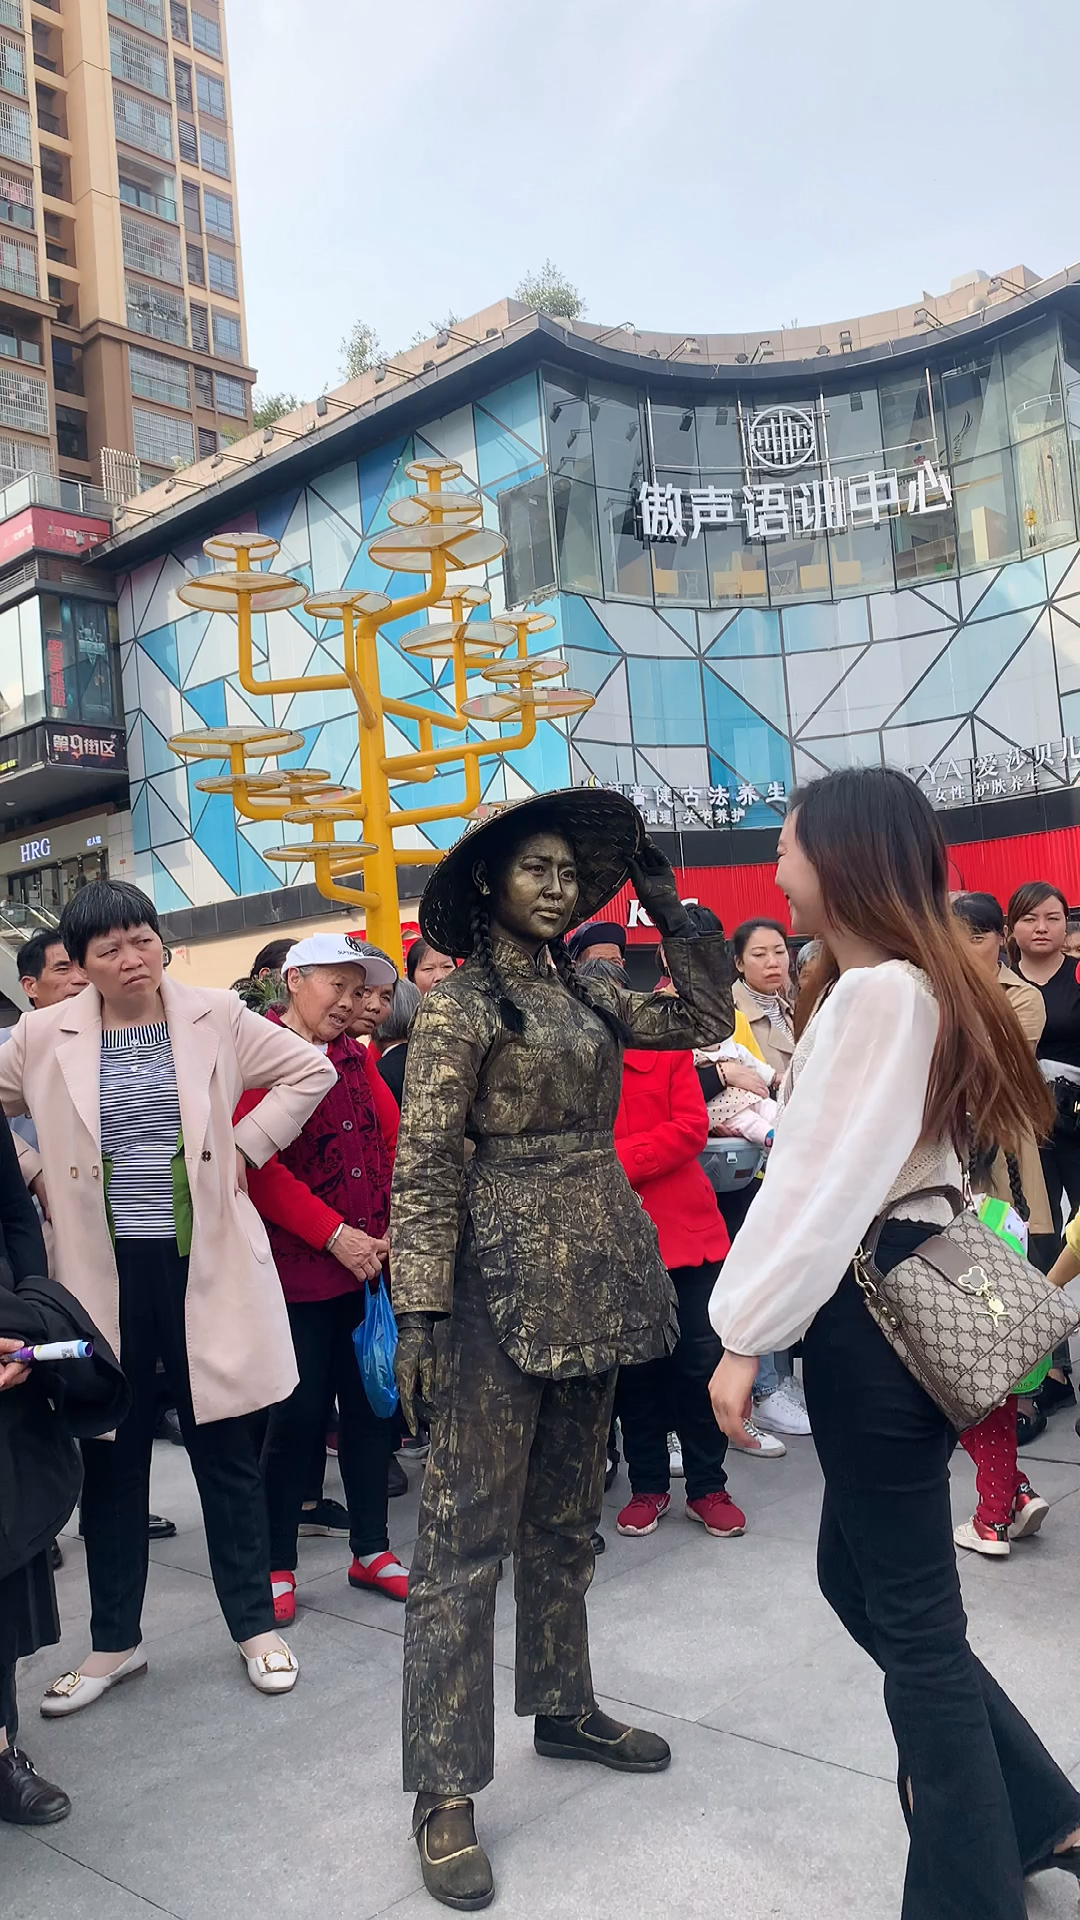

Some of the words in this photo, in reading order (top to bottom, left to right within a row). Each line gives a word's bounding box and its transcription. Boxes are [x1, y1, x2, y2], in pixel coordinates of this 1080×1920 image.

[639, 461, 952, 539] 傲声语训中心
[53, 734, 116, 759] 第9街区
[976, 771, 1040, 797] 护肤养生
[641, 808, 673, 825] 调理
[683, 807, 745, 825] 关节养护
[20, 838, 51, 862] HRG
